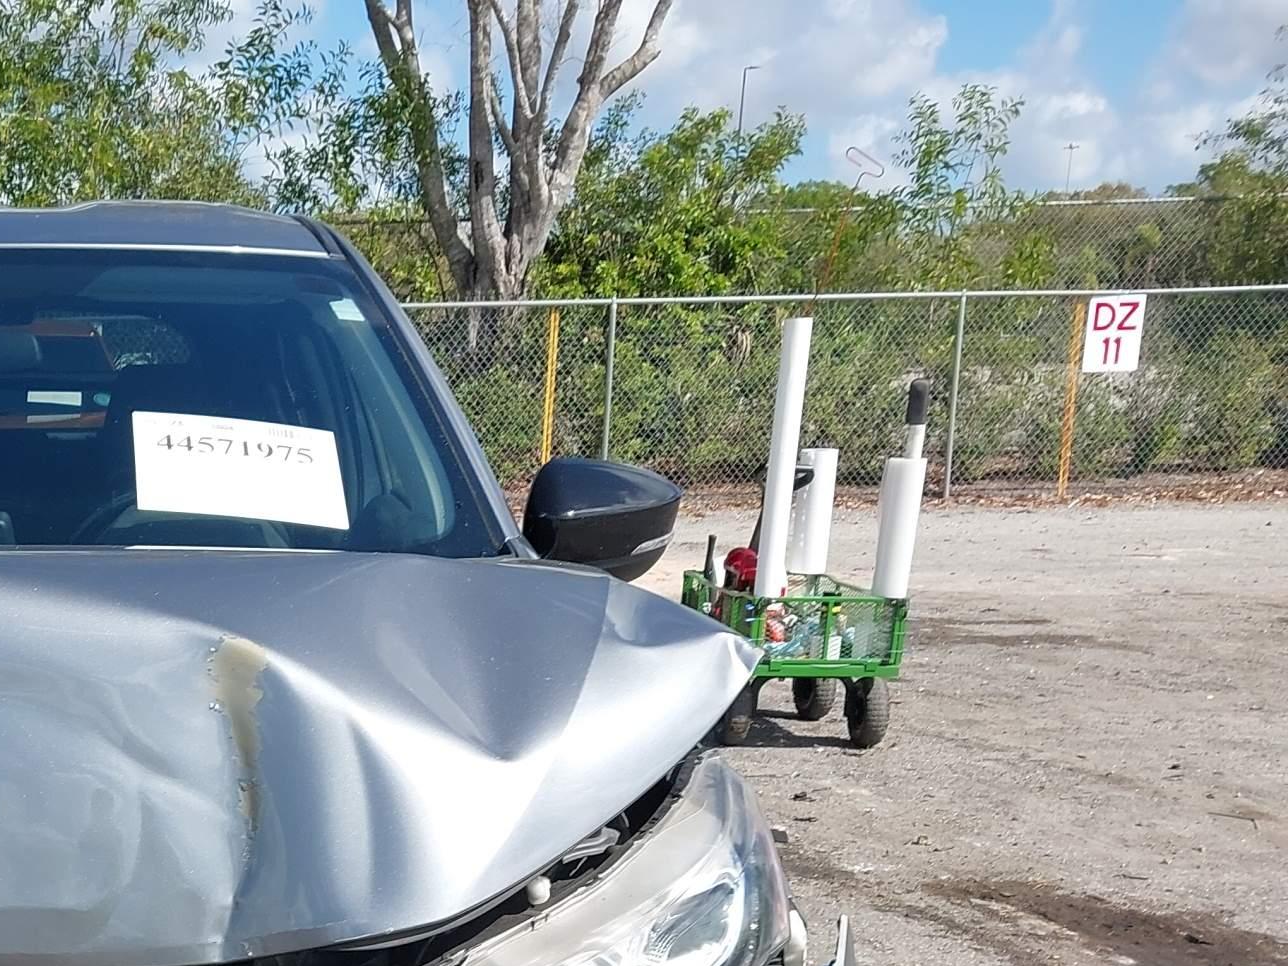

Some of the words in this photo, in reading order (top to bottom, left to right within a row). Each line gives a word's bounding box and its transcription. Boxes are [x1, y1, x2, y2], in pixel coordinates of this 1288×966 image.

[1093, 302, 1140, 331] DZ
[1102, 336, 1122, 365] 11
[157, 434, 314, 464] 44571975
